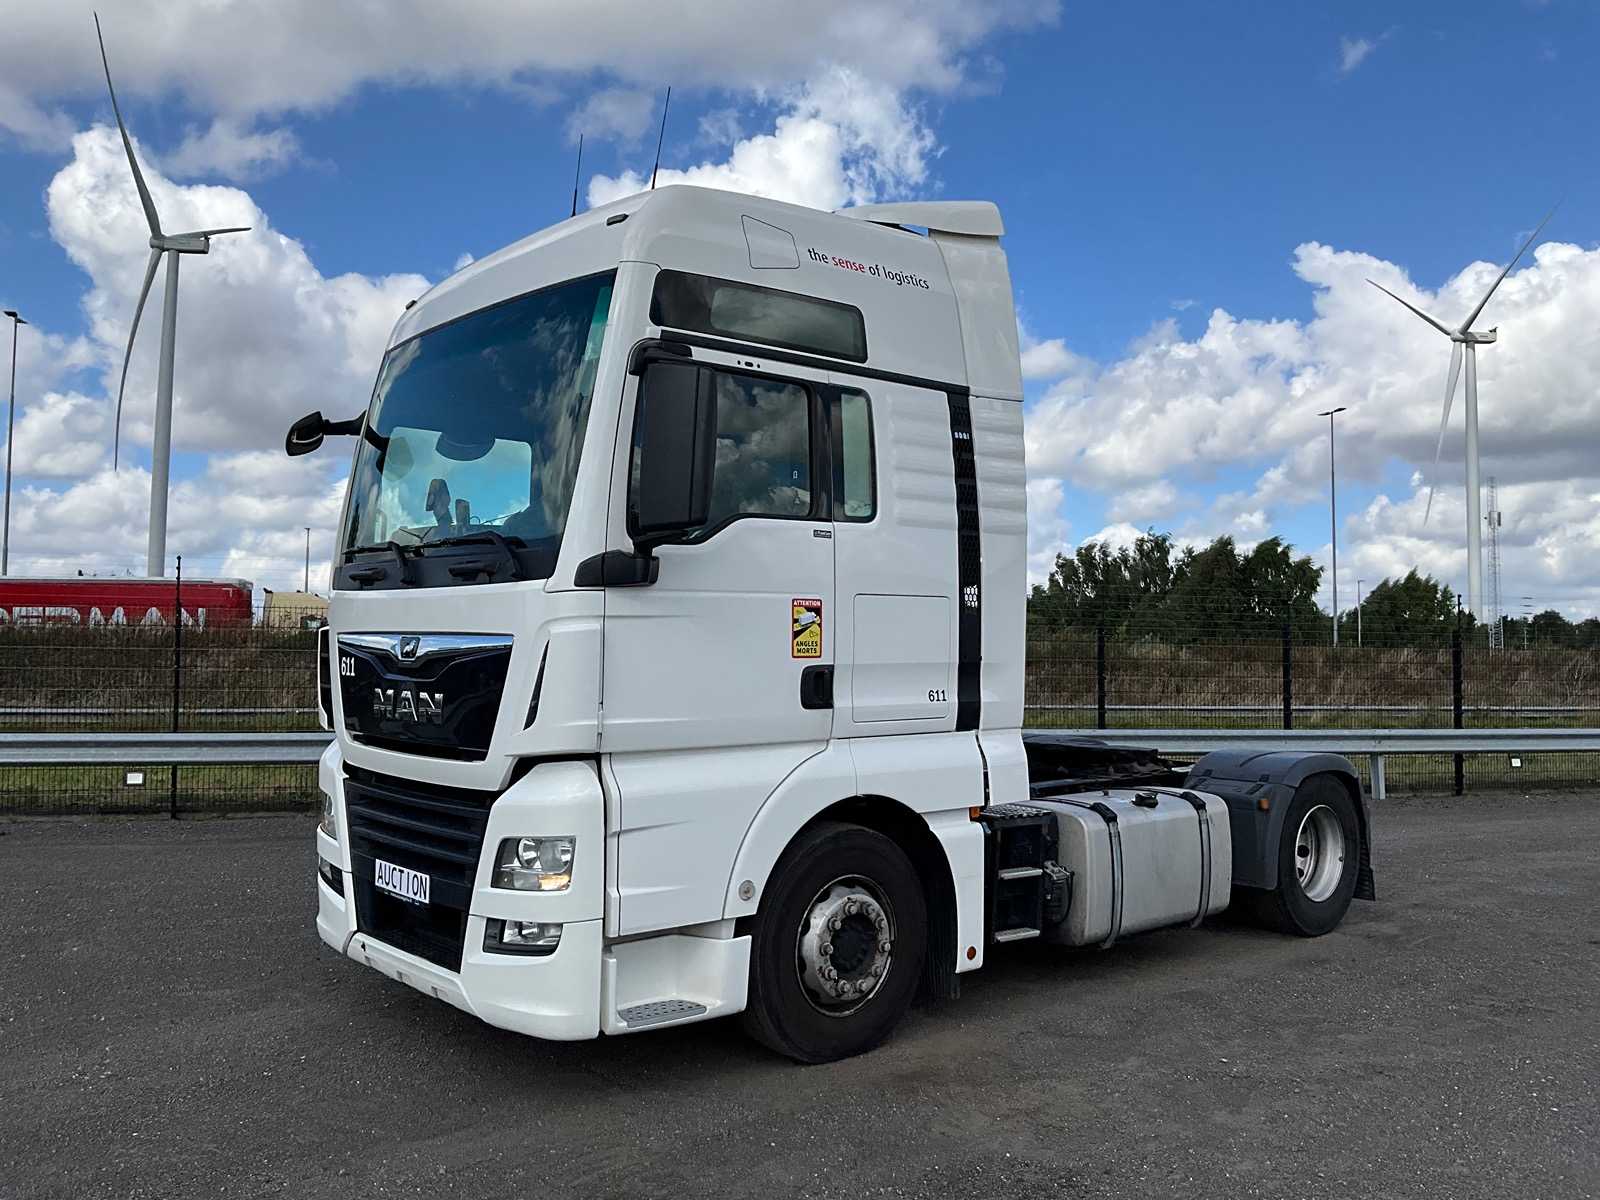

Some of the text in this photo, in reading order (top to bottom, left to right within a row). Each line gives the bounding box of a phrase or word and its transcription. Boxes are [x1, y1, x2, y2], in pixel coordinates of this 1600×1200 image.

[807, 247, 930, 290] the sense of logistics
[795, 640, 818, 648] ANGLES
[796, 647, 817, 655] MORTS
[341, 656, 355, 677] 611
[373, 687, 444, 723] MAN
[928, 688, 948, 703] 611
[376, 861, 428, 901] AUCTION
